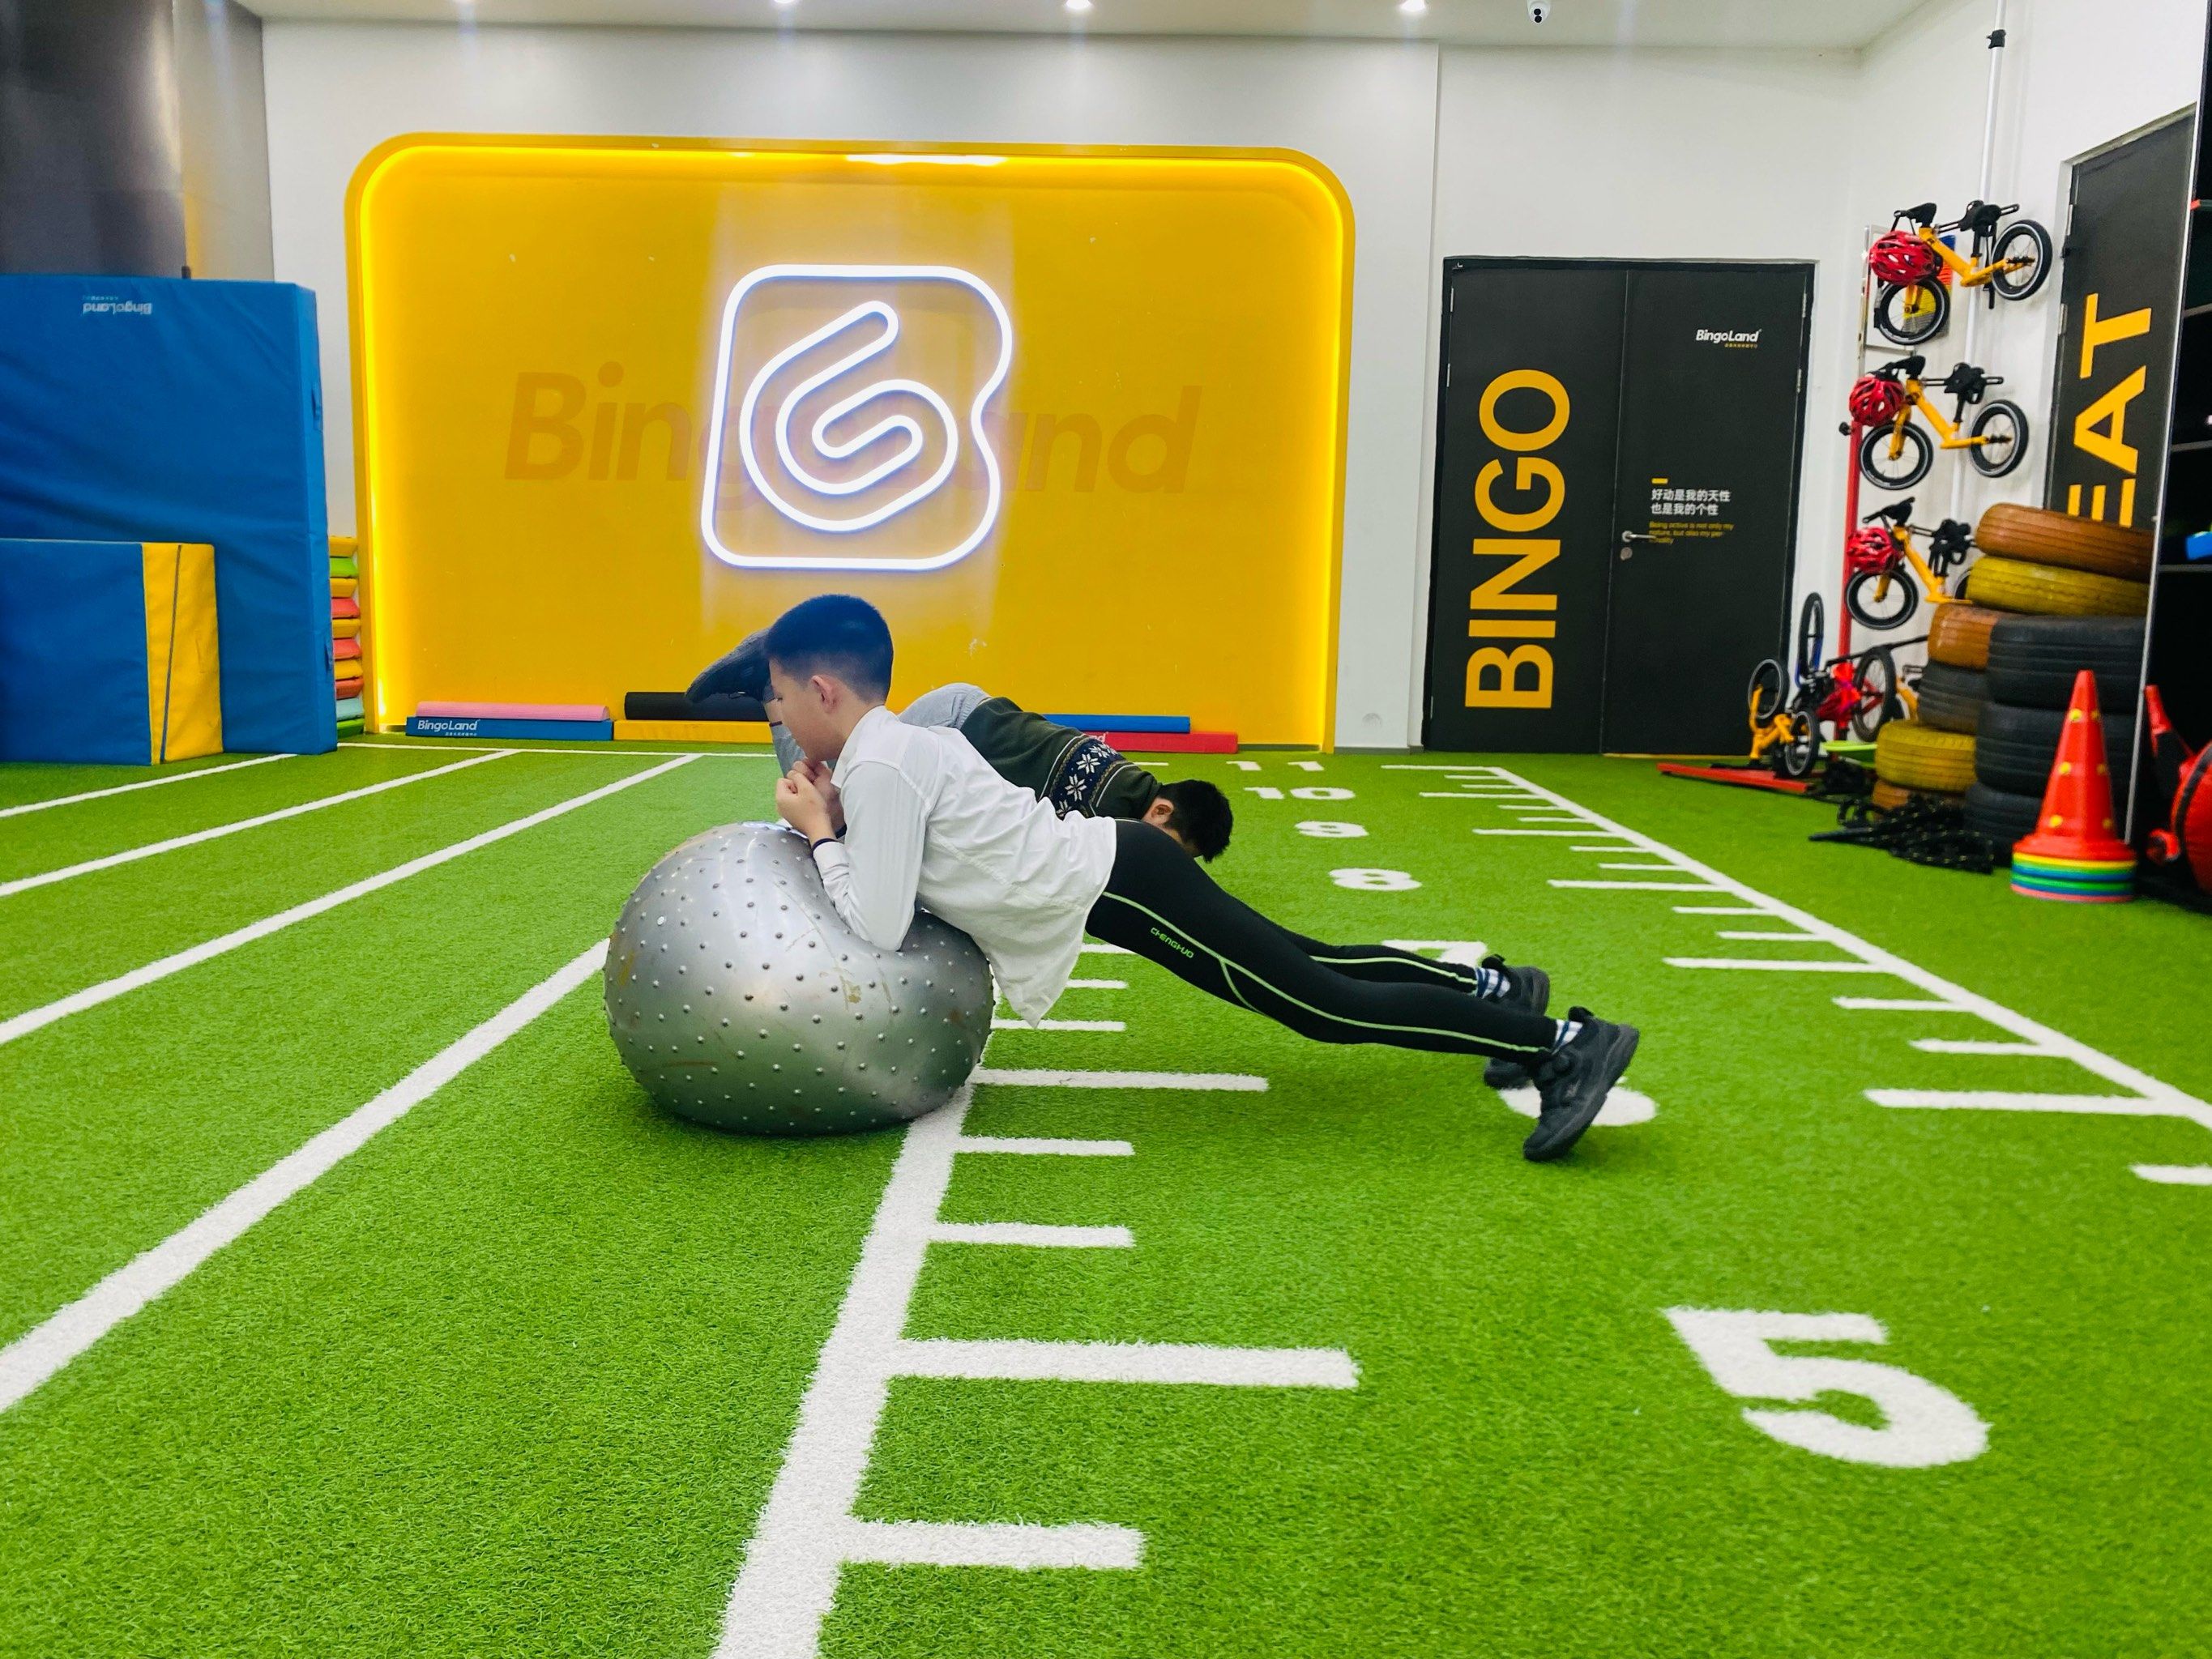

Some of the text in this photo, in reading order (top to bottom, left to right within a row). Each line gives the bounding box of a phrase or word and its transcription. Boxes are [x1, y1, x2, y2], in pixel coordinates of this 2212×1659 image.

[1696, 328, 1761, 343] BingoLand
[1651, 488, 1731, 502] 好动是我的天性
[1651, 503, 1719, 516] 也是我的个性
[1465, 369, 1570, 709] BINGO
[417, 719, 478, 732] BingoLand
[1243, 787, 1356, 800] 10
[1294, 821, 1369, 838] 9
[1328, 868, 1422, 891] 8
[1659, 1306, 1992, 1468] 5
